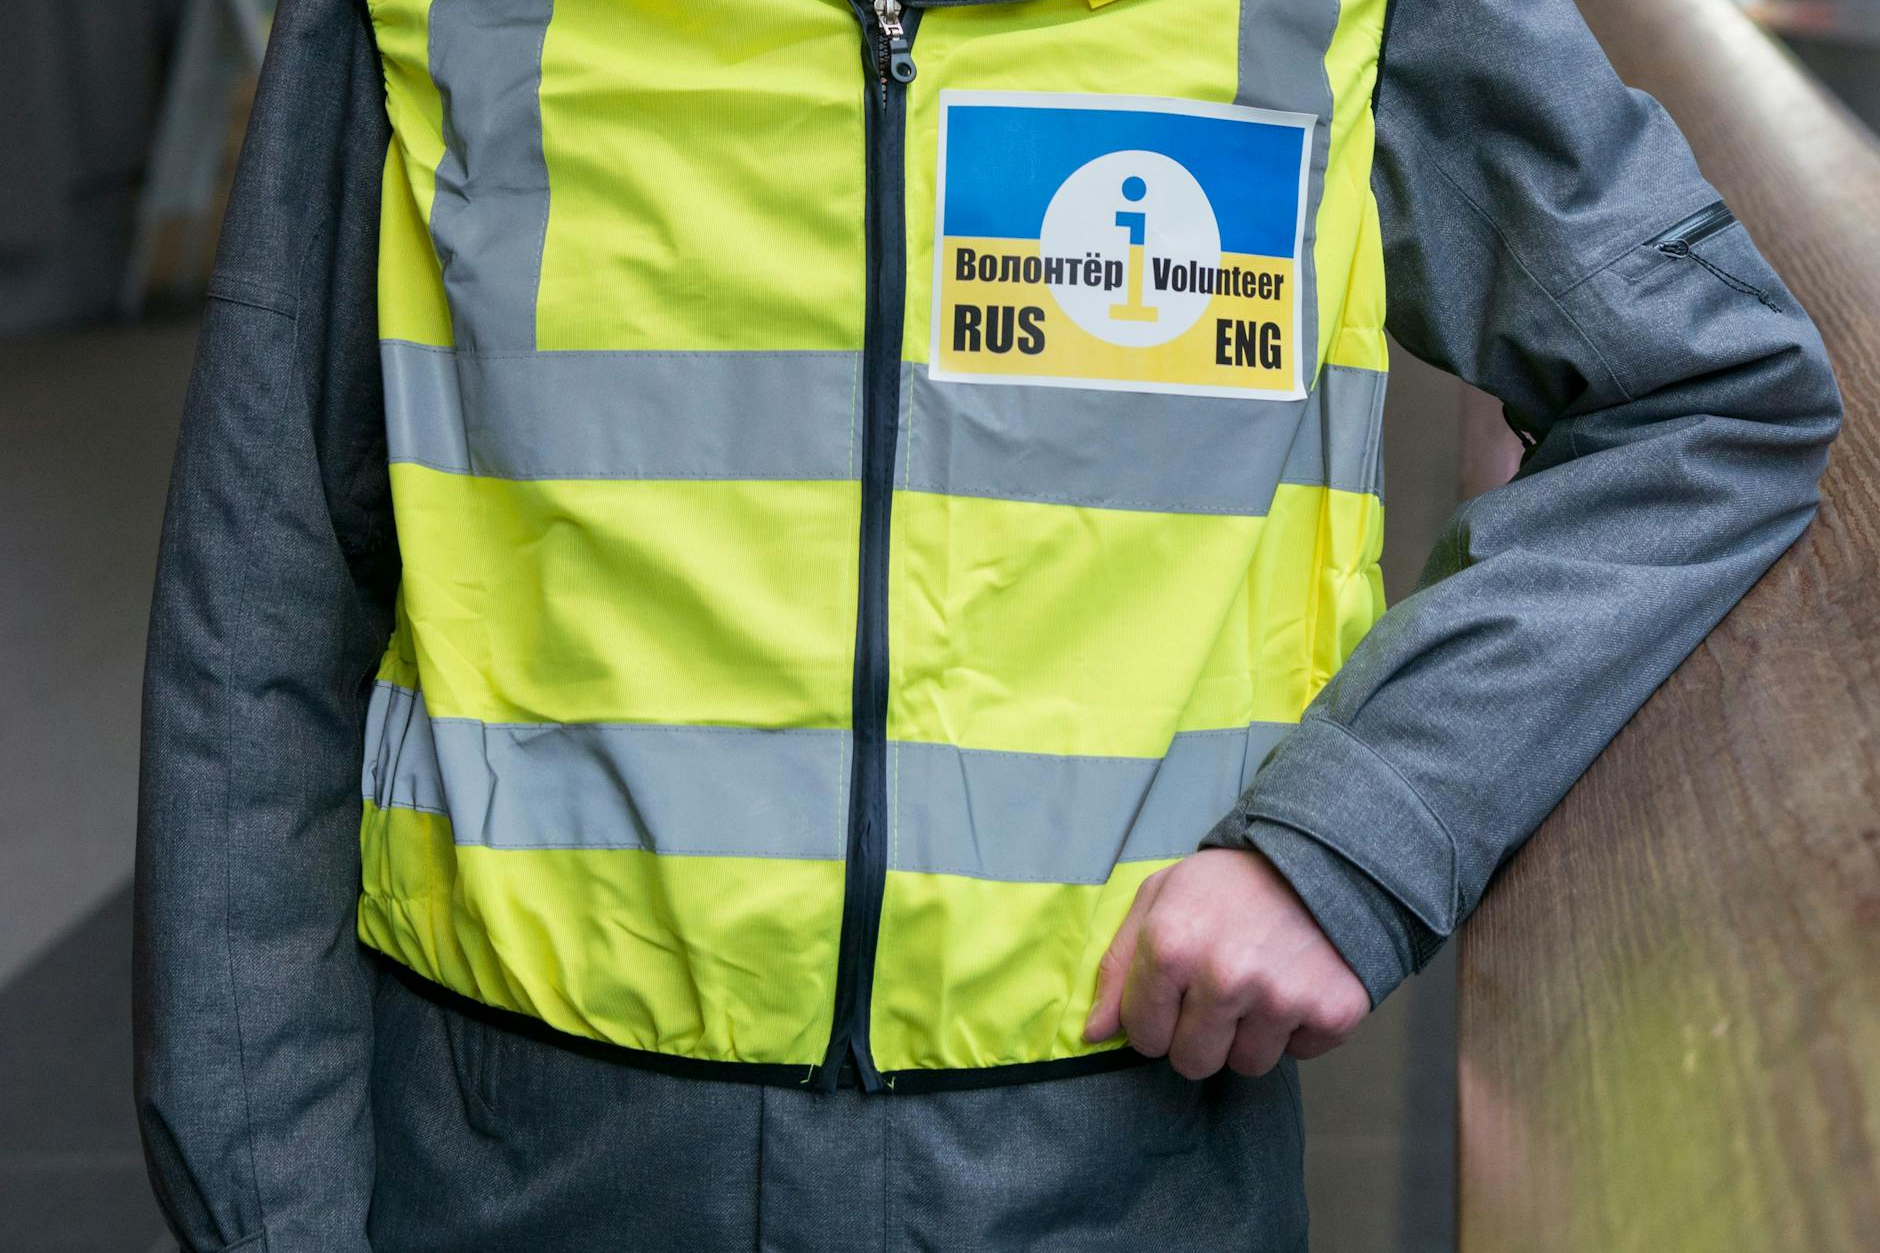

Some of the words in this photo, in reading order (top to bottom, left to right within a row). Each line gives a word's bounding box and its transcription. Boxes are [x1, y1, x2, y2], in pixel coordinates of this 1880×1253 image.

[955, 247, 1124, 291] Волонтёр
[1153, 258, 1284, 301] Volunteer
[953, 304, 1046, 354] RUS
[1215, 318, 1282, 370] ENG
